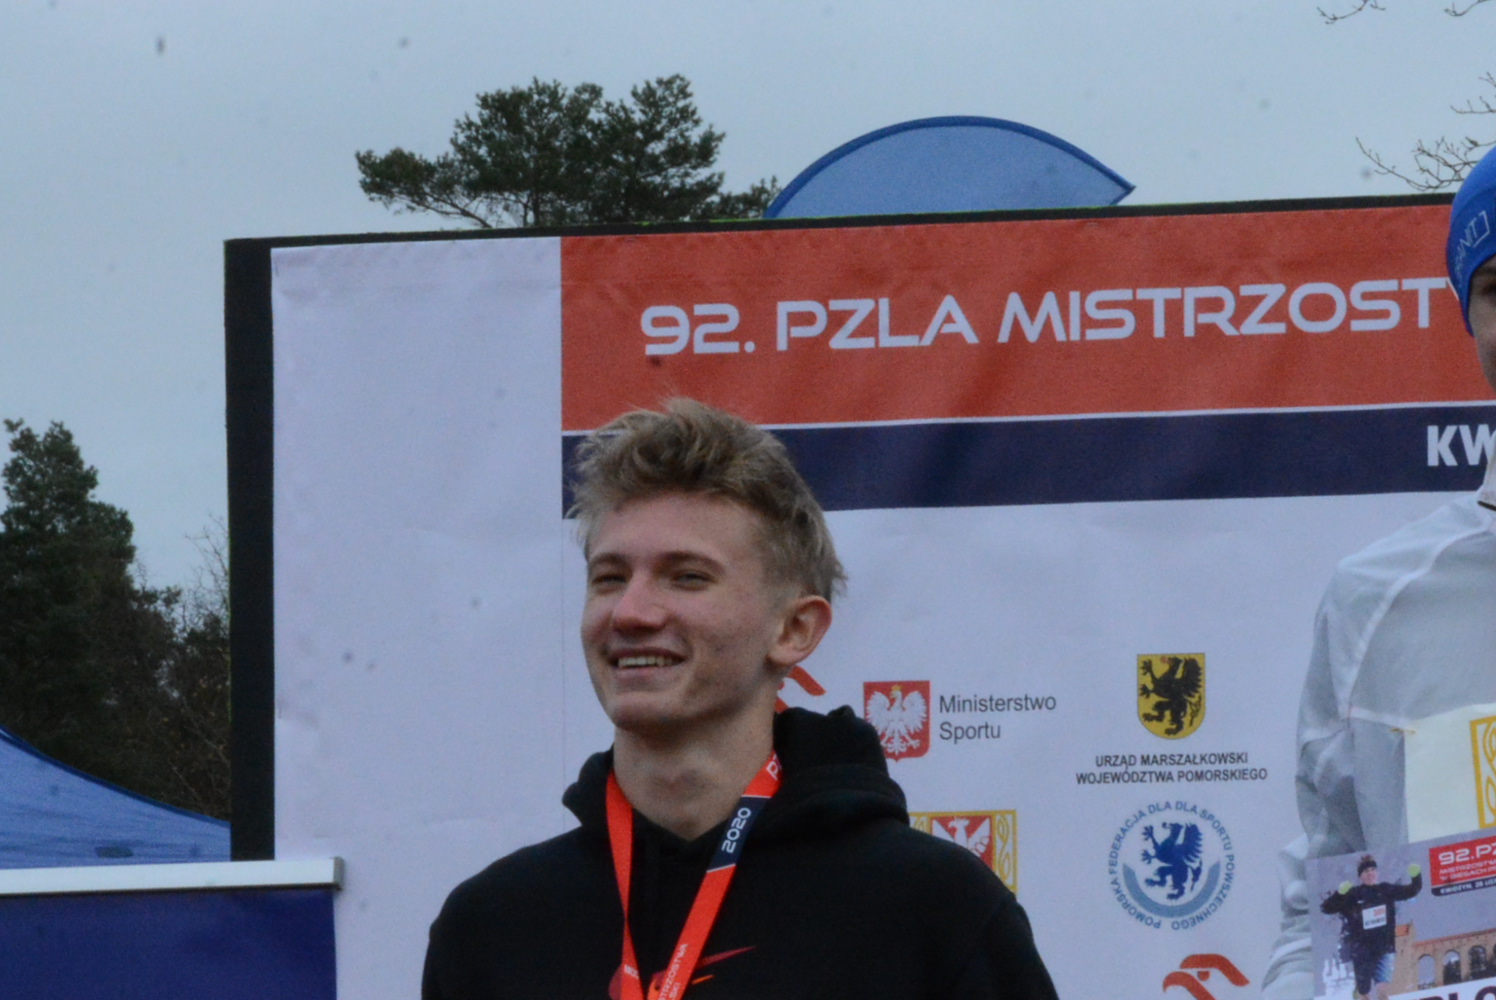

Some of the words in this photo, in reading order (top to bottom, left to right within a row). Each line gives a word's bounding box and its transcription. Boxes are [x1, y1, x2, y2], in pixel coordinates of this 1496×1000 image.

[641, 303, 756, 356] 92.
[775, 294, 980, 352] PZLA
[997, 276, 1459, 344] MISTRZOST
[939, 693, 1058, 714] Ministerstwo
[939, 721, 1002, 745] Sportu
[1095, 755, 1138, 771] URZĄD
[1140, 751, 1249, 767] MARSZAŁKOWSKI
[1076, 769, 1175, 785] WOJEWÓDZTWA
[1177, 768, 1269, 783] POMORSKIEGO
[720, 806, 751, 854] 2020
